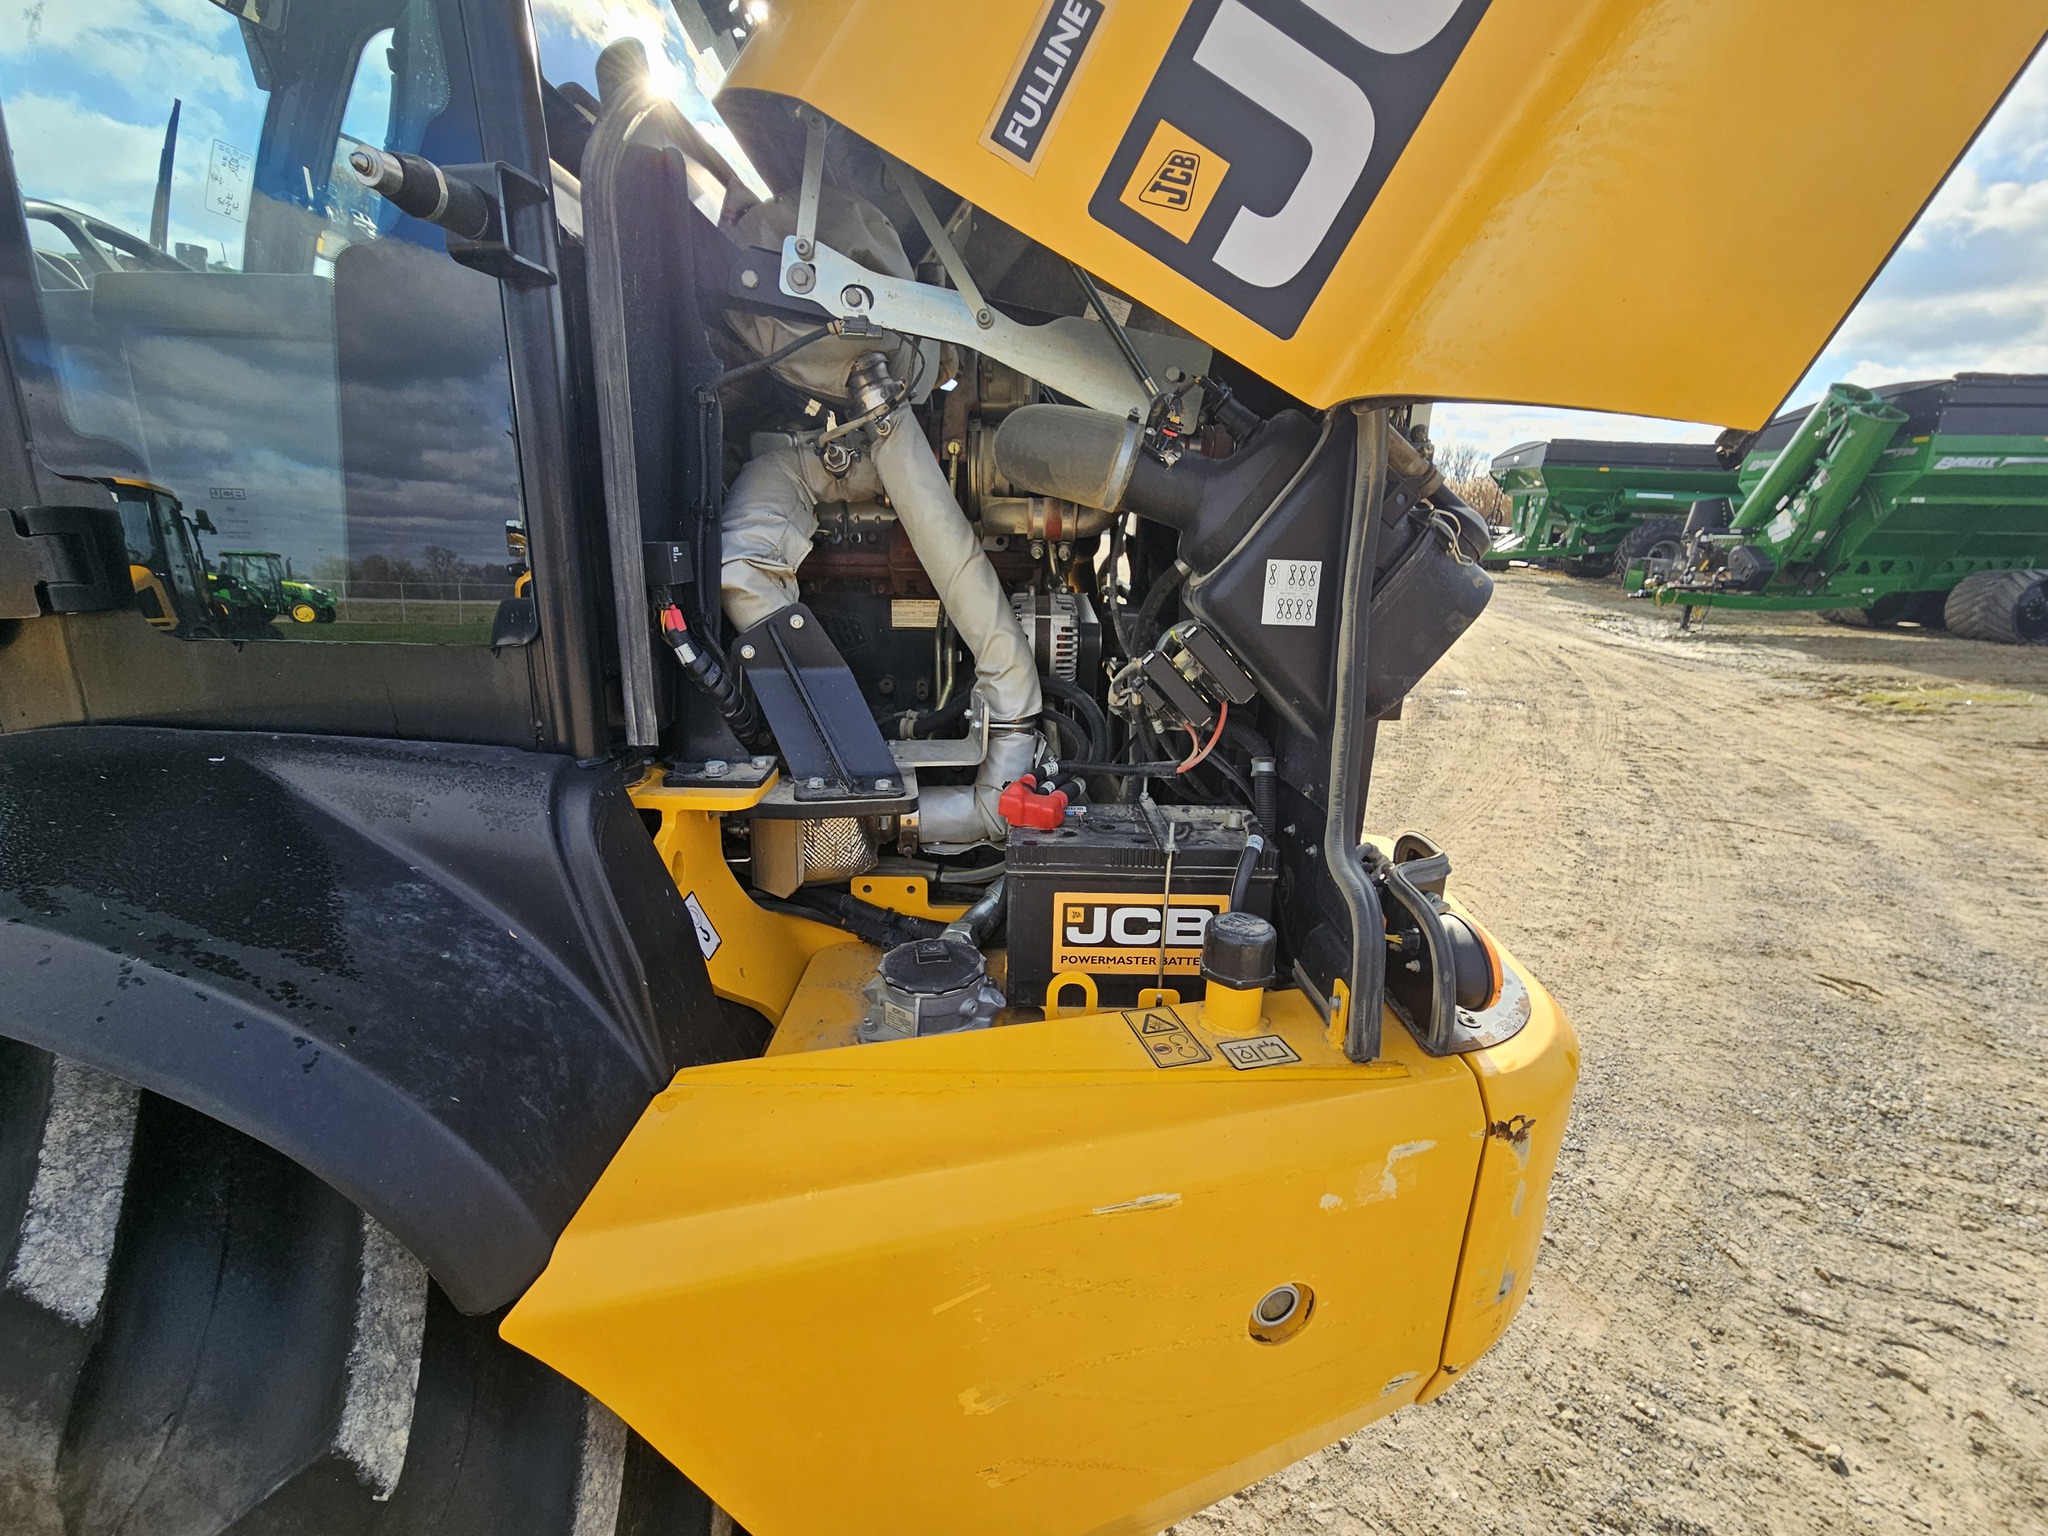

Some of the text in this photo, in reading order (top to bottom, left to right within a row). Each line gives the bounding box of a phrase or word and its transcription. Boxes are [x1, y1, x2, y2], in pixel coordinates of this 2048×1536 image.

[1004, 0, 1091, 149] FULLINE
[1148, 155, 1196, 206] JCB
[210, 488, 245, 499] JCB
[1066, 907, 1214, 945] JCB
[1060, 955, 1201, 966] POWERMASTER BATTE
